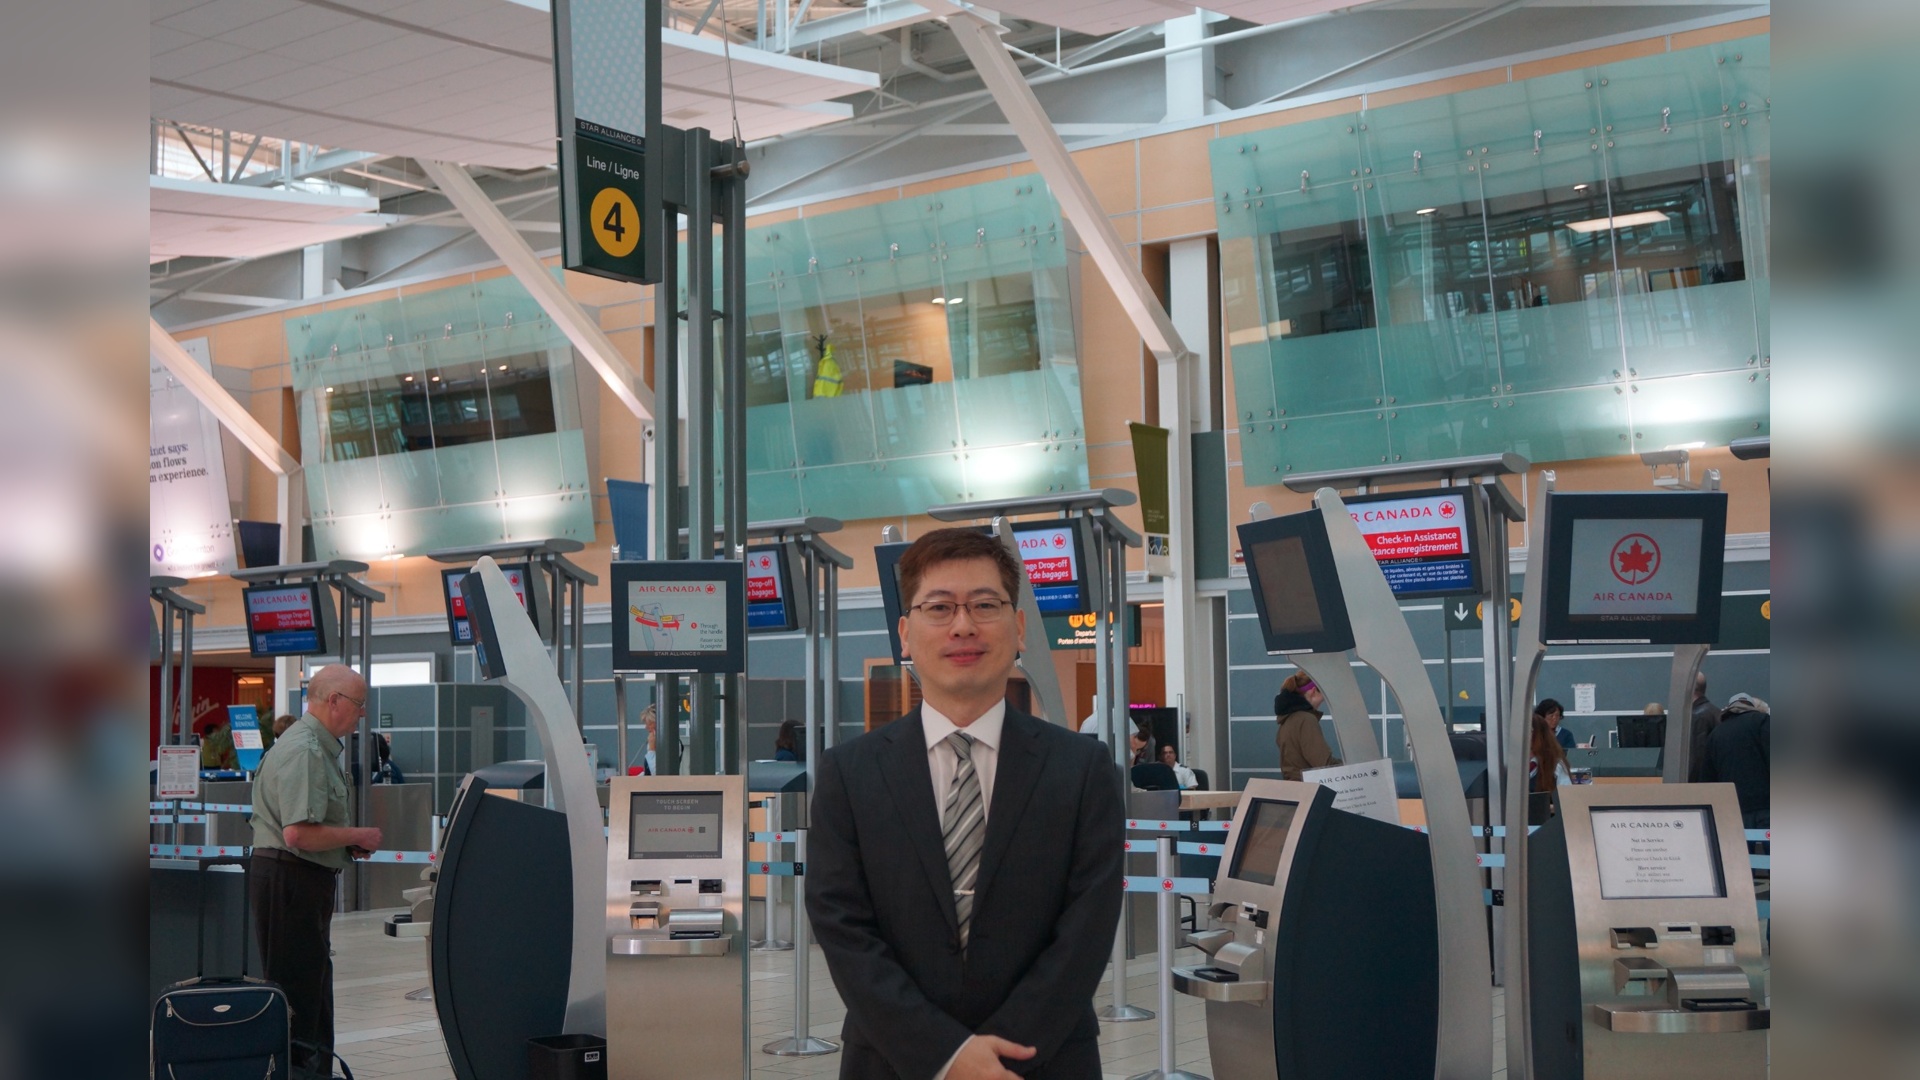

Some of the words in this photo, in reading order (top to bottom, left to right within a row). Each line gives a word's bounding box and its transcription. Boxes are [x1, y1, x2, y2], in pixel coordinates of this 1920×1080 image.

[580, 121, 599, 133] STAR
[600, 128, 637, 144] ALLIANCE
[586, 155, 607, 171] Line
[614, 163, 640, 180] Ligne
[603, 201, 625, 242] 4
[168, 444, 188, 455] says:
[150, 460, 162, 470] on
[163, 457, 187, 468] flows
[158, 467, 209, 483] experience.
[1364, 507, 1432, 522] CANADA
[1017, 538, 1047, 549] ADA
[1377, 535, 1412, 545] Check-in
[1413, 532, 1457, 542] Assistance
[1149, 545, 1168, 556] YVR
[1396, 542, 1458, 555] enregistrement
[1038, 559, 1068, 570] Drop-off
[1033, 571, 1041, 579] de
[1042, 570, 1069, 580] bagages
[748, 579, 773, 588] Drop-off
[751, 589, 774, 598] bagages
[1593, 592, 1615, 601] AIR
[1618, 592, 1673, 601] CANADA
[253, 597, 265, 605] AIR
[267, 595, 298, 604] CANADA
[1335, 772, 1369, 782] CANADA
